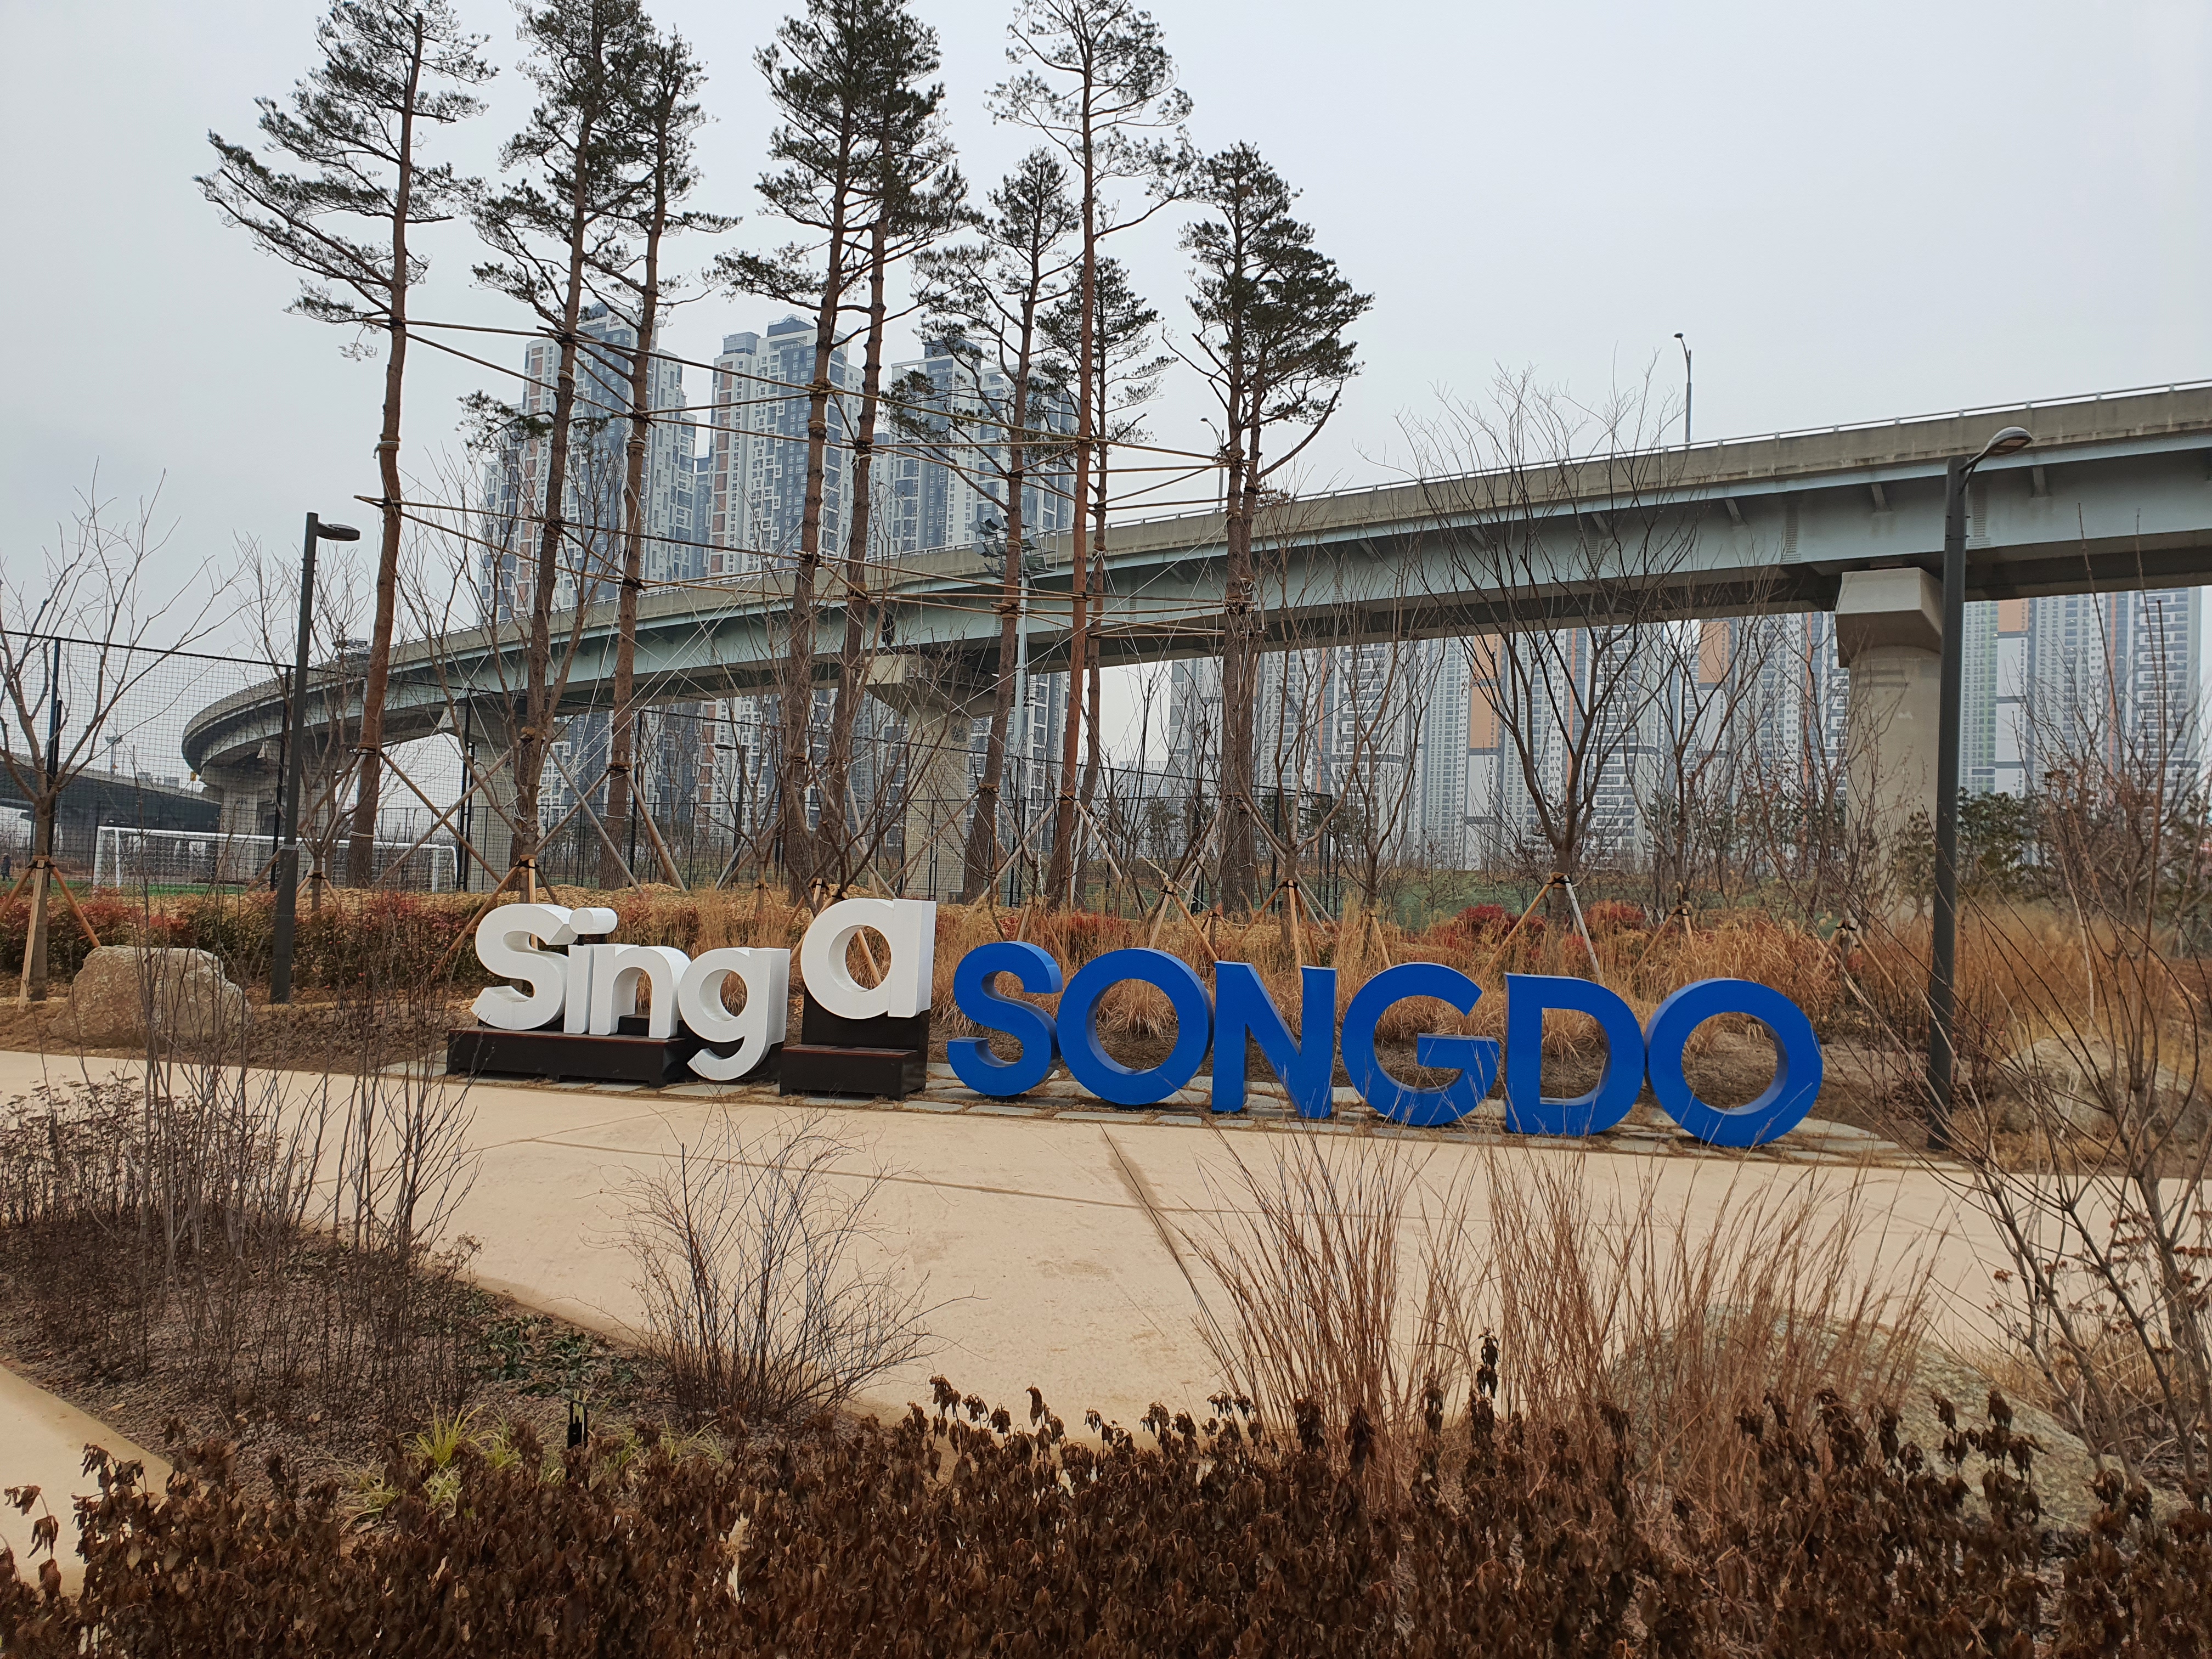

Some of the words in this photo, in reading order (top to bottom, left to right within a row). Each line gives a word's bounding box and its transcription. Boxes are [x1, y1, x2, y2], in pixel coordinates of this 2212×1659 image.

[471, 903, 791, 1081] Sing
[800, 898, 937, 1019] a
[946, 940, 1822, 1147] SONGDO
